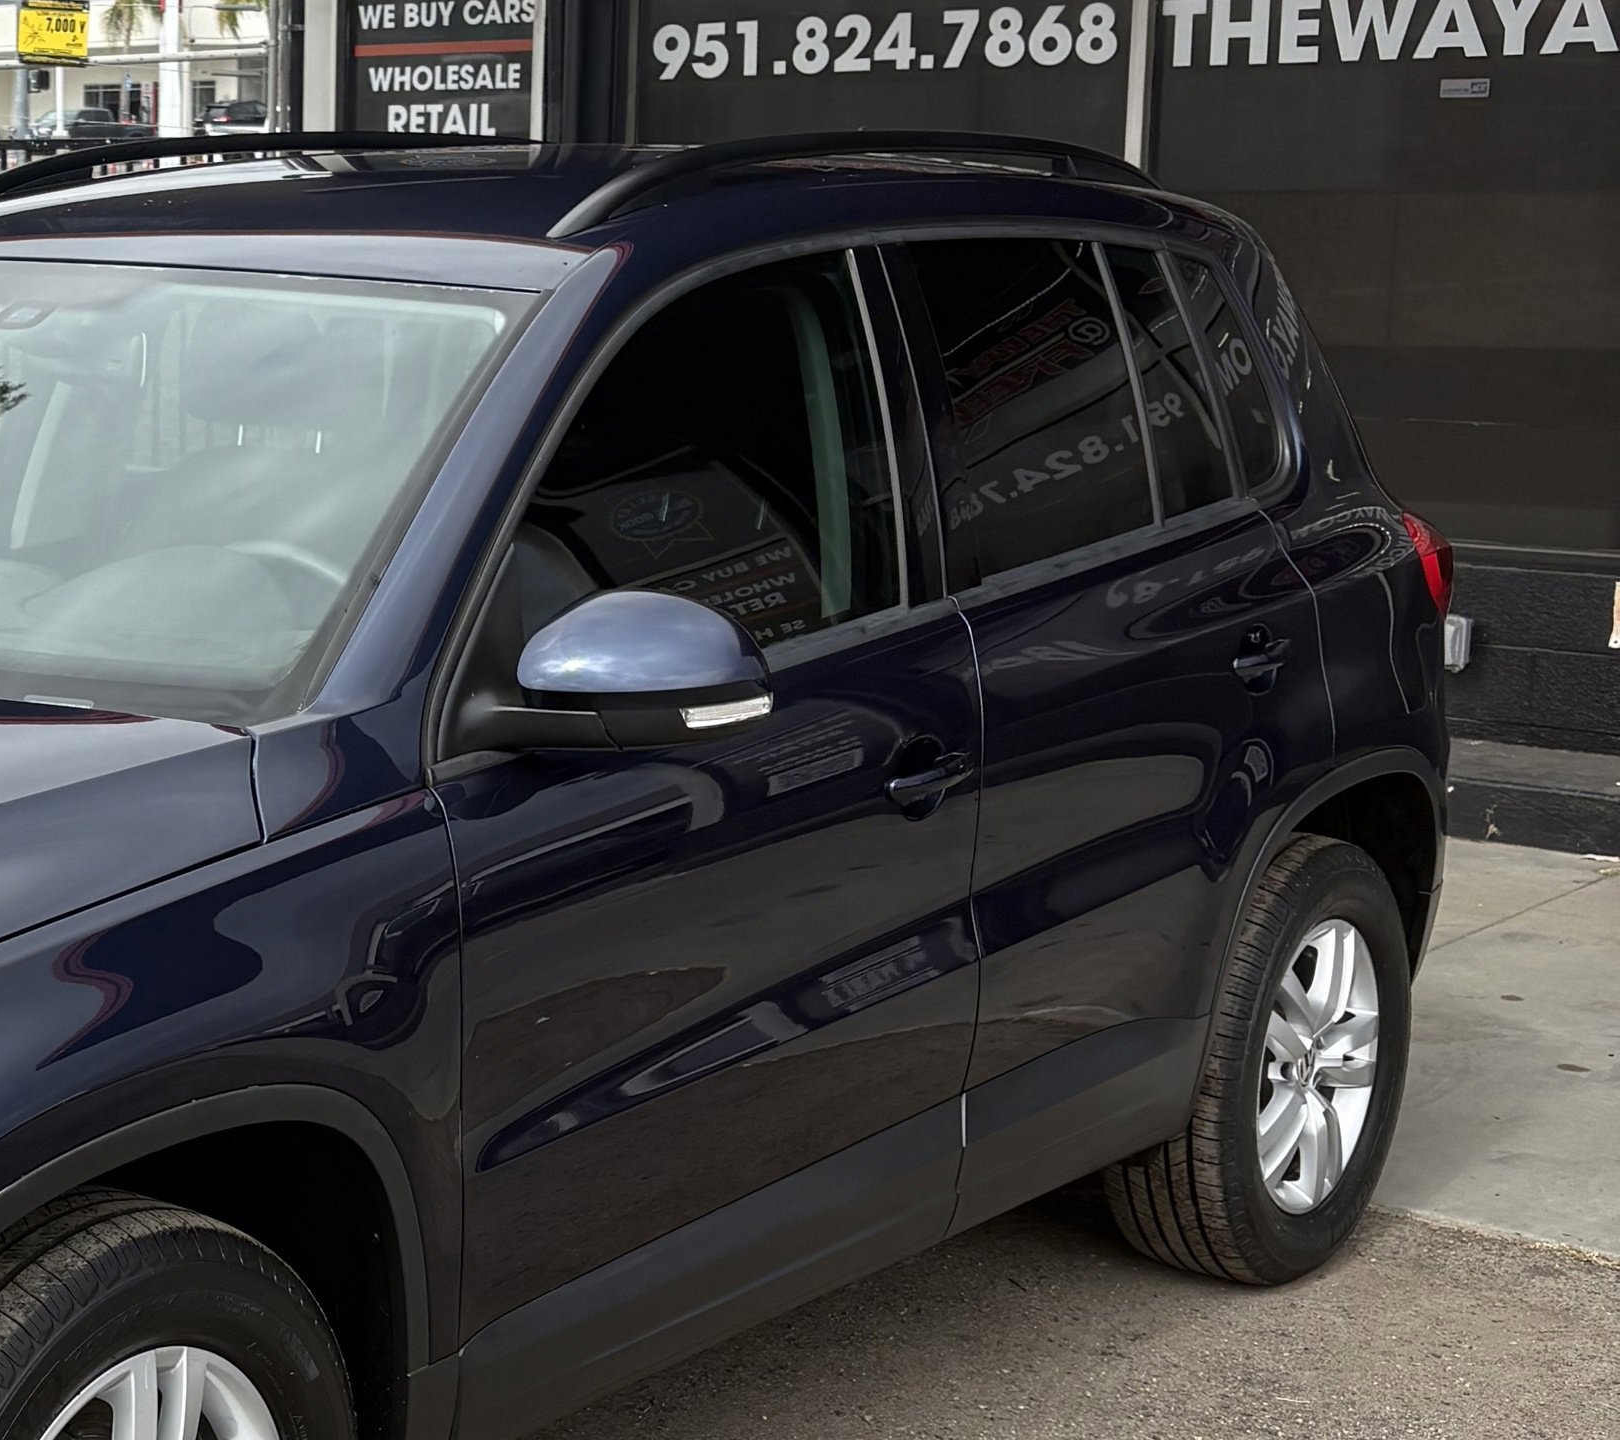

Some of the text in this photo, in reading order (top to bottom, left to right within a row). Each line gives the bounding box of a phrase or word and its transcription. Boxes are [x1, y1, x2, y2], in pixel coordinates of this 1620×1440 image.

[46, 17, 76, 34] 7,000
[358, 4, 396, 30] WE
[403, 0, 455, 28] BUY
[652, 2, 1118, 81] 951.824.7868
[368, 63, 521, 92] WHOLESALE
[387, 103, 497, 137] RETAIL
